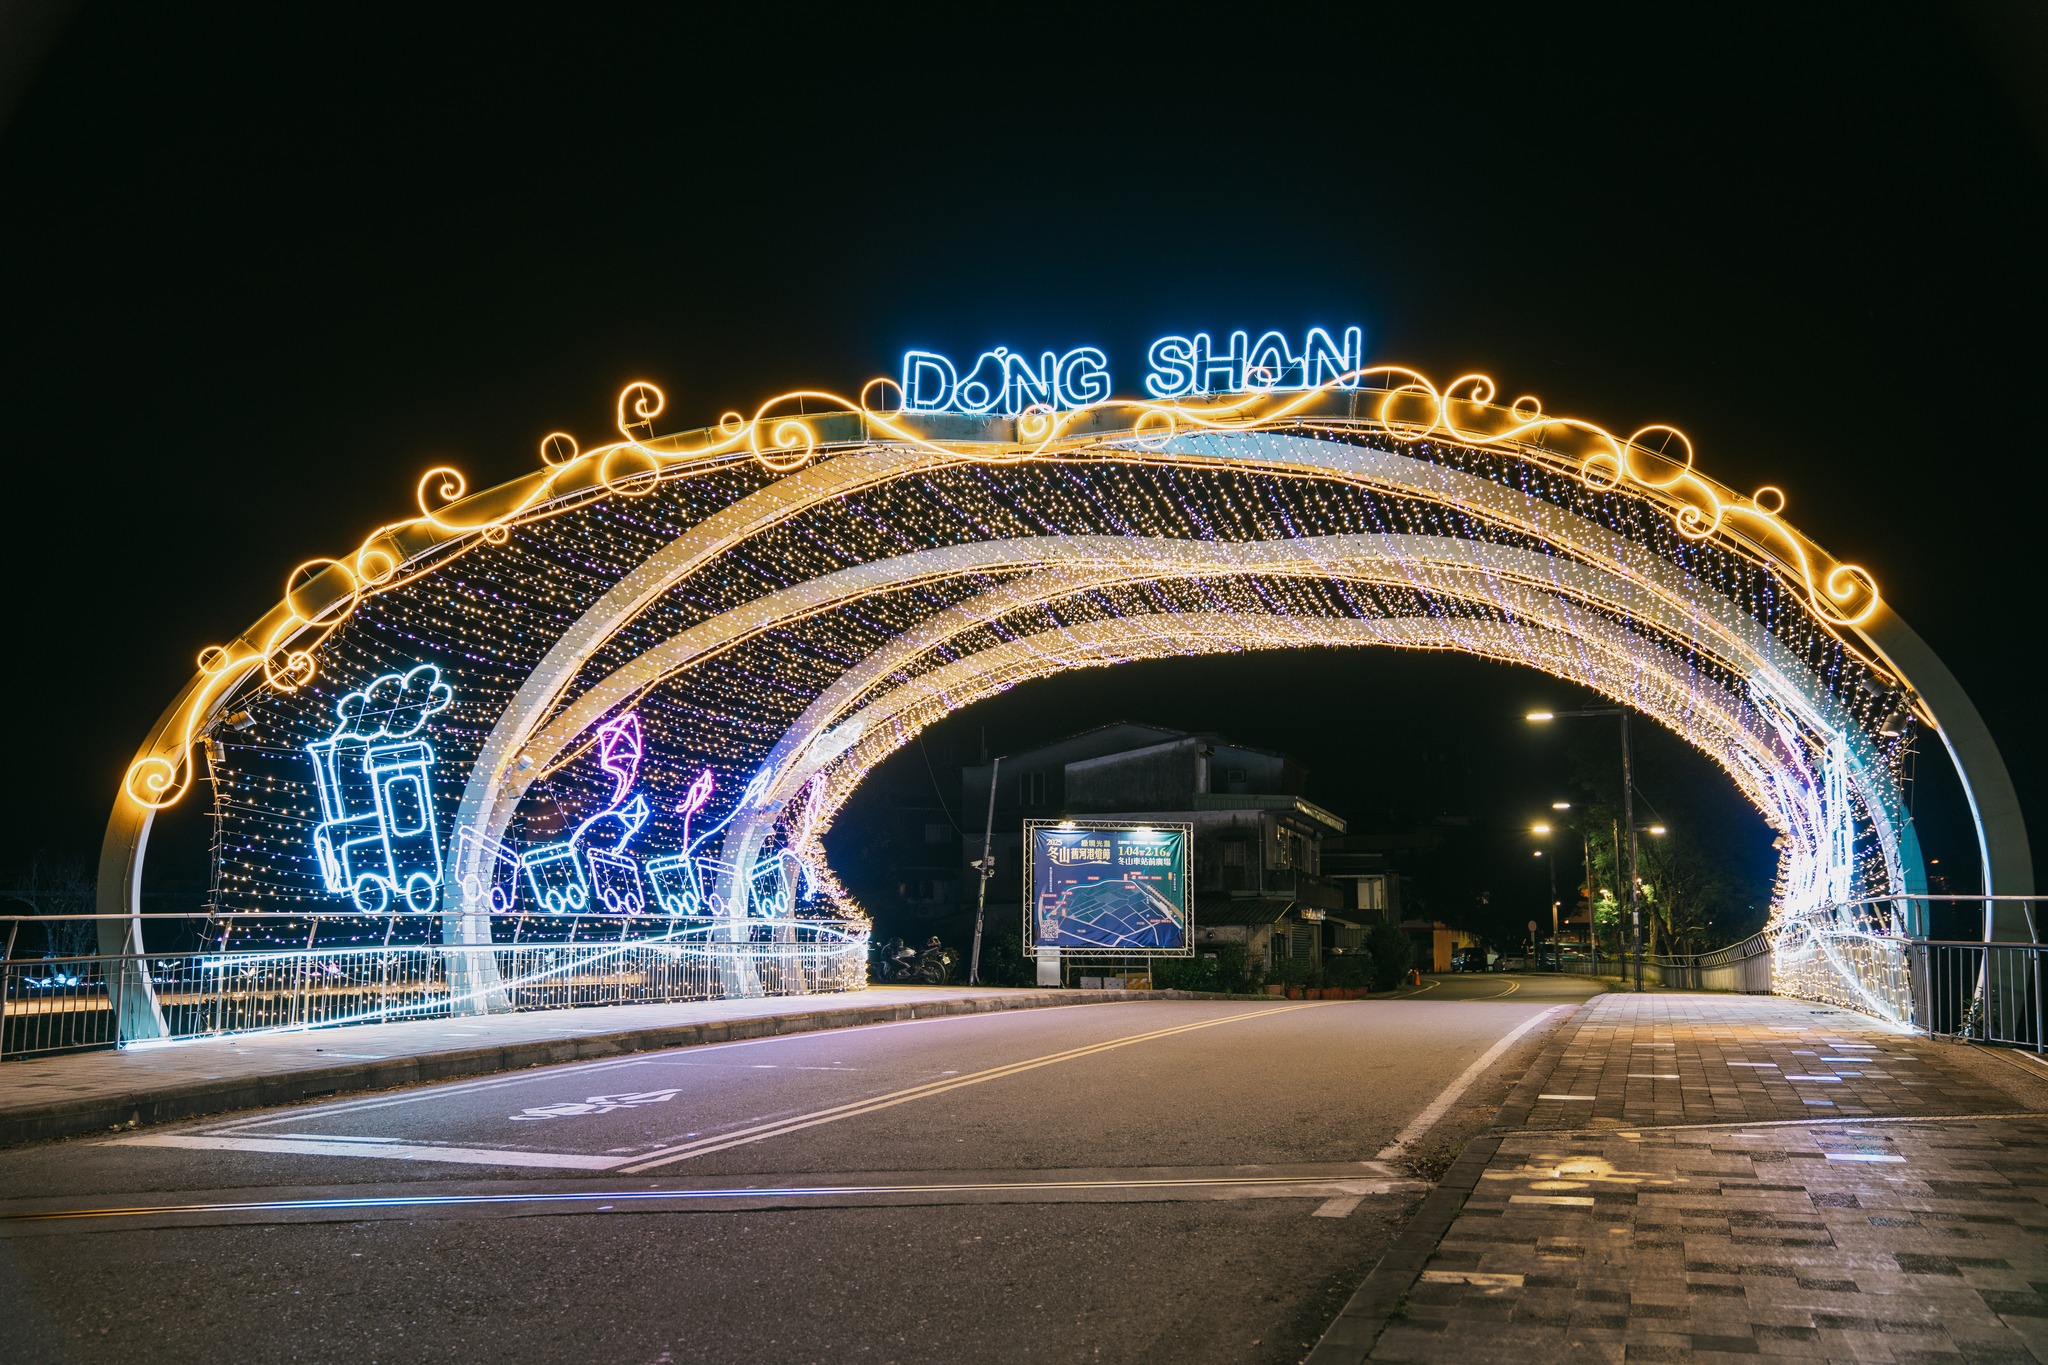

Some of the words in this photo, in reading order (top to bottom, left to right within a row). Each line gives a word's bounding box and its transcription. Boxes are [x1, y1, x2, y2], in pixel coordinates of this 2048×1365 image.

[901, 347, 1112, 415] DONG
[1145, 326, 1362, 398] SHAN
[1118, 857, 1171, 866] 冬山車站前廣場
